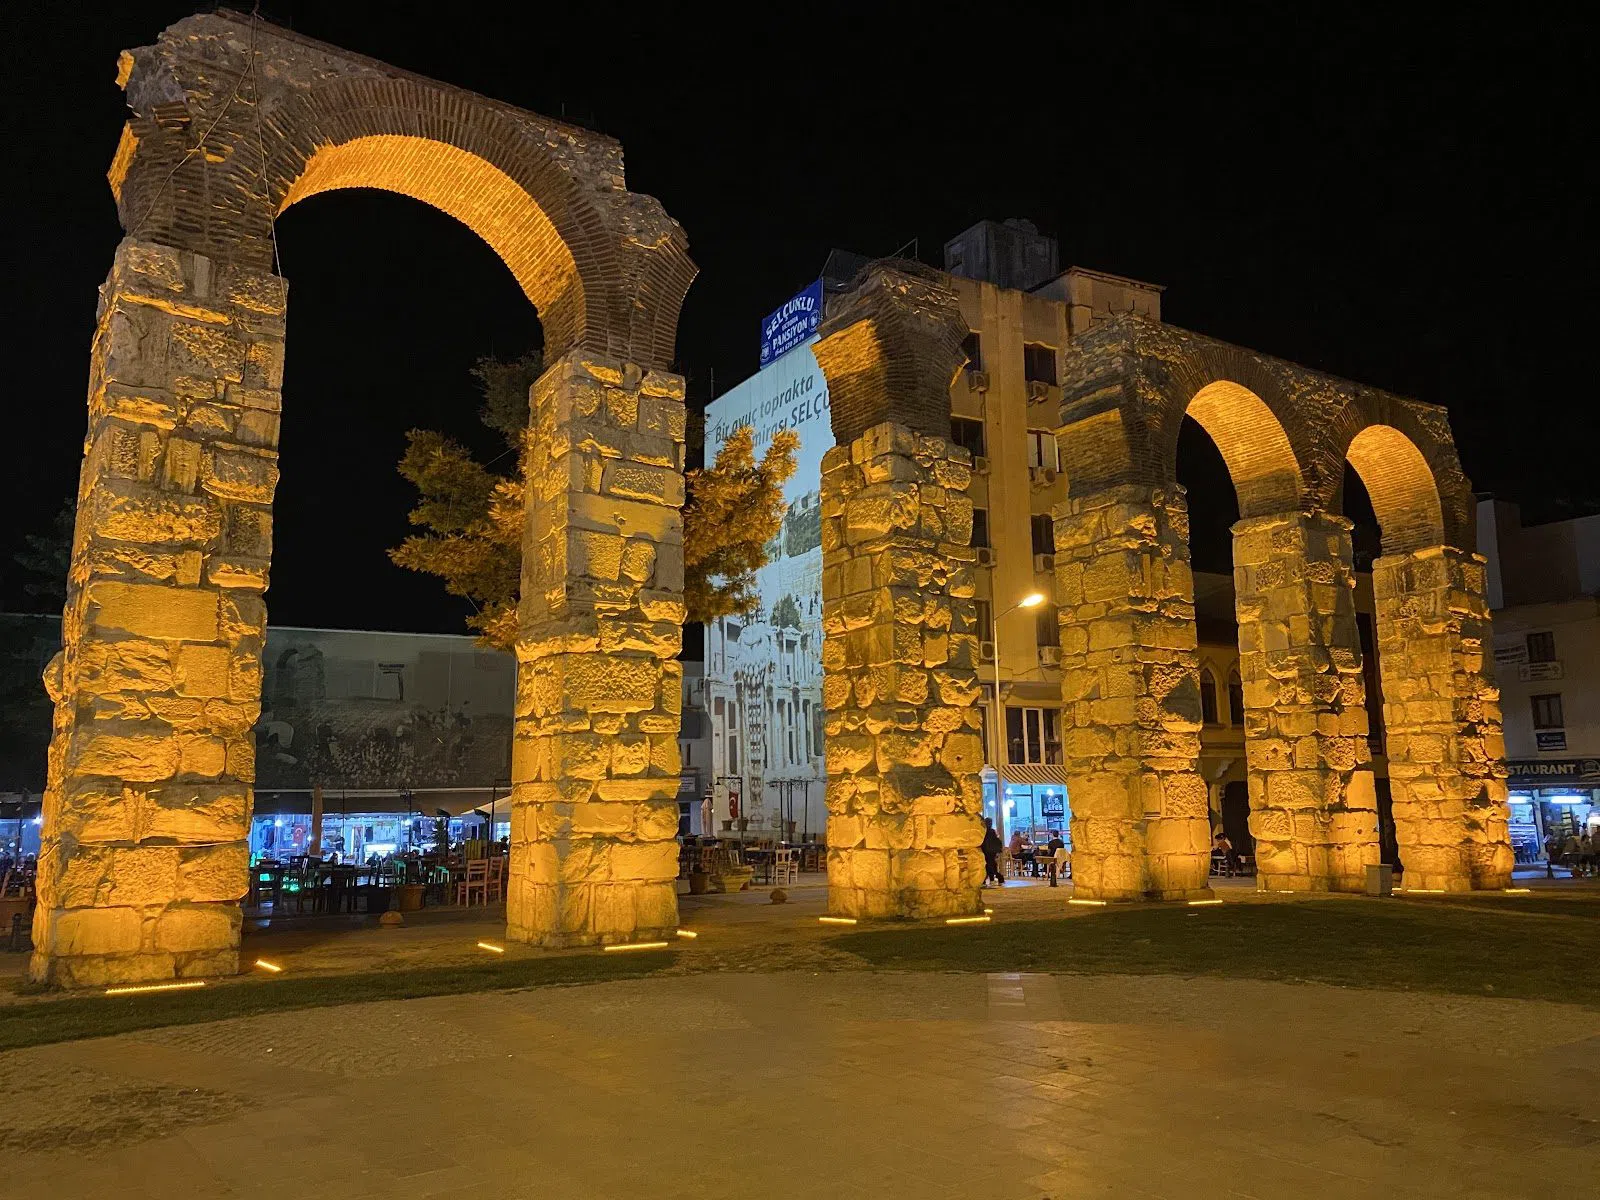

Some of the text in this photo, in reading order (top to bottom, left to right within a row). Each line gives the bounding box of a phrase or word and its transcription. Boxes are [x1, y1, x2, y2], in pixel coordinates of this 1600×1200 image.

[766, 296, 814, 340] SELÇUKLU
[715, 374, 813, 444] Bir avuç toprakta
